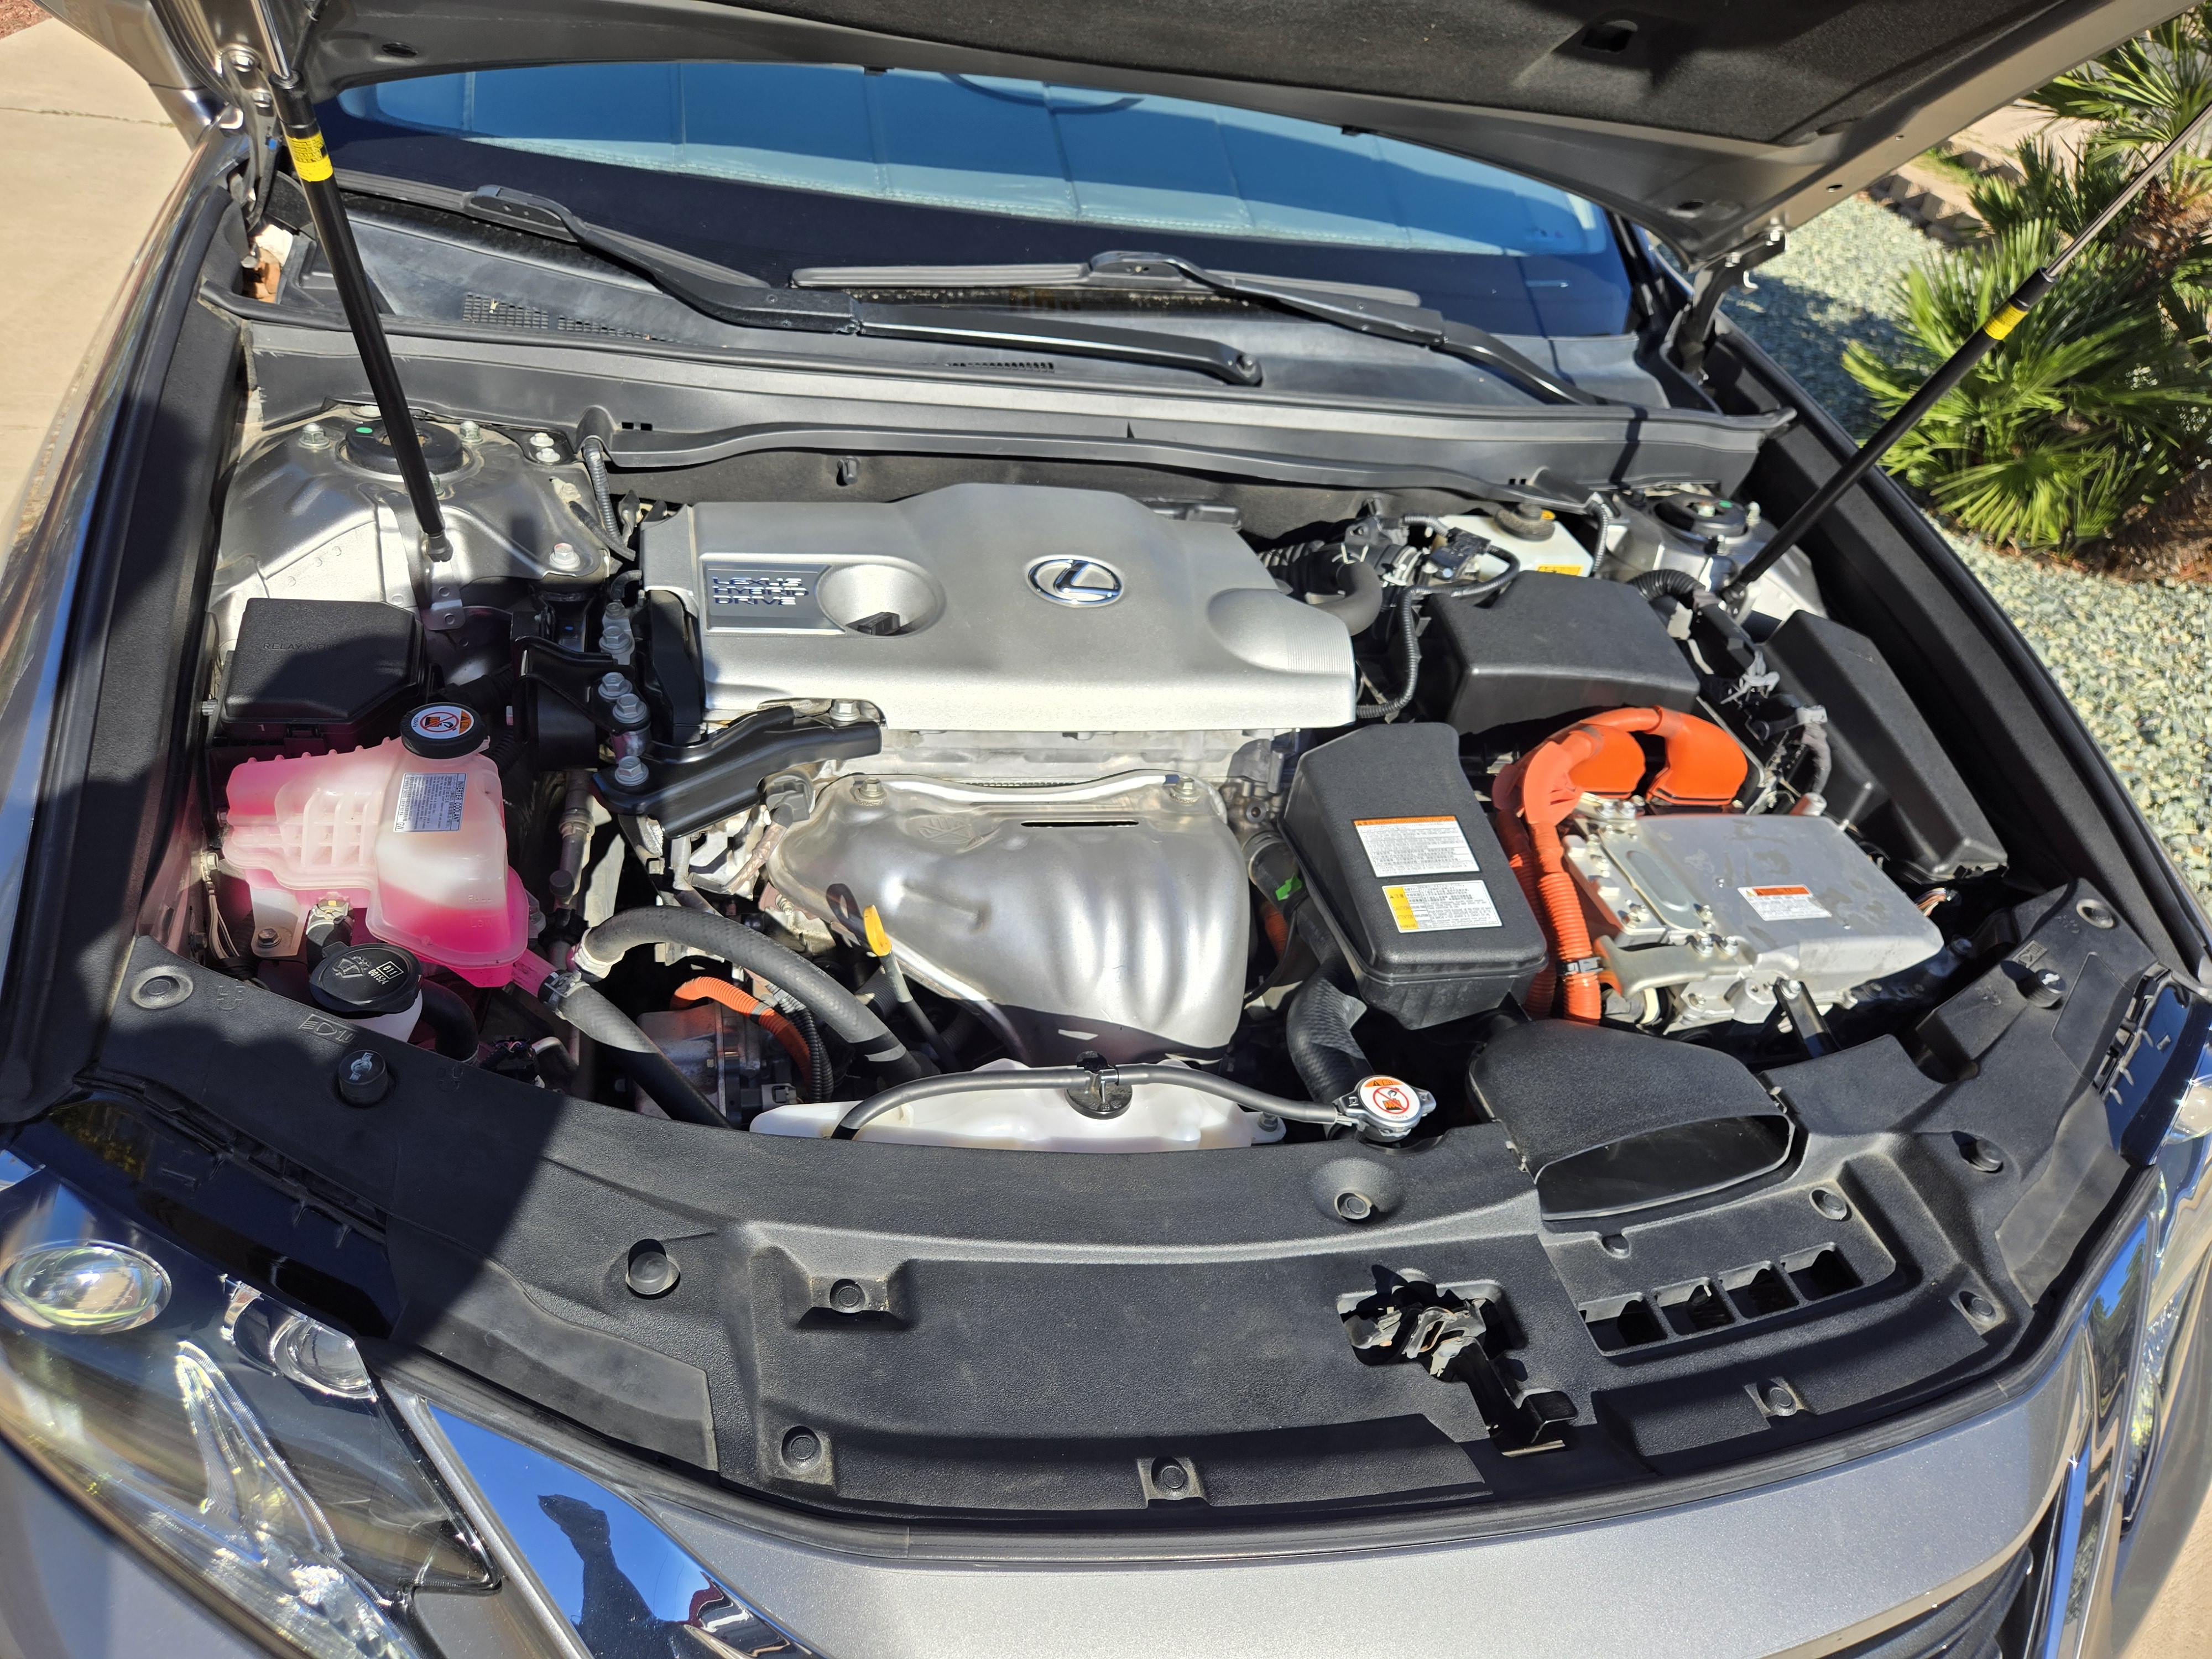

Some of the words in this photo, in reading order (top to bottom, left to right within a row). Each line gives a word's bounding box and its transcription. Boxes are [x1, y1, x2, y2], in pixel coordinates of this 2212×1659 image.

[712, 577, 802, 586] LEXUS
[712, 586, 809, 596] HYBRID
[713, 595, 796, 606] DRIVE
[456, 781, 465, 800] INVERTER
[453, 802, 462, 822] COOLANT
[368, 969, 389, 985] 001524
